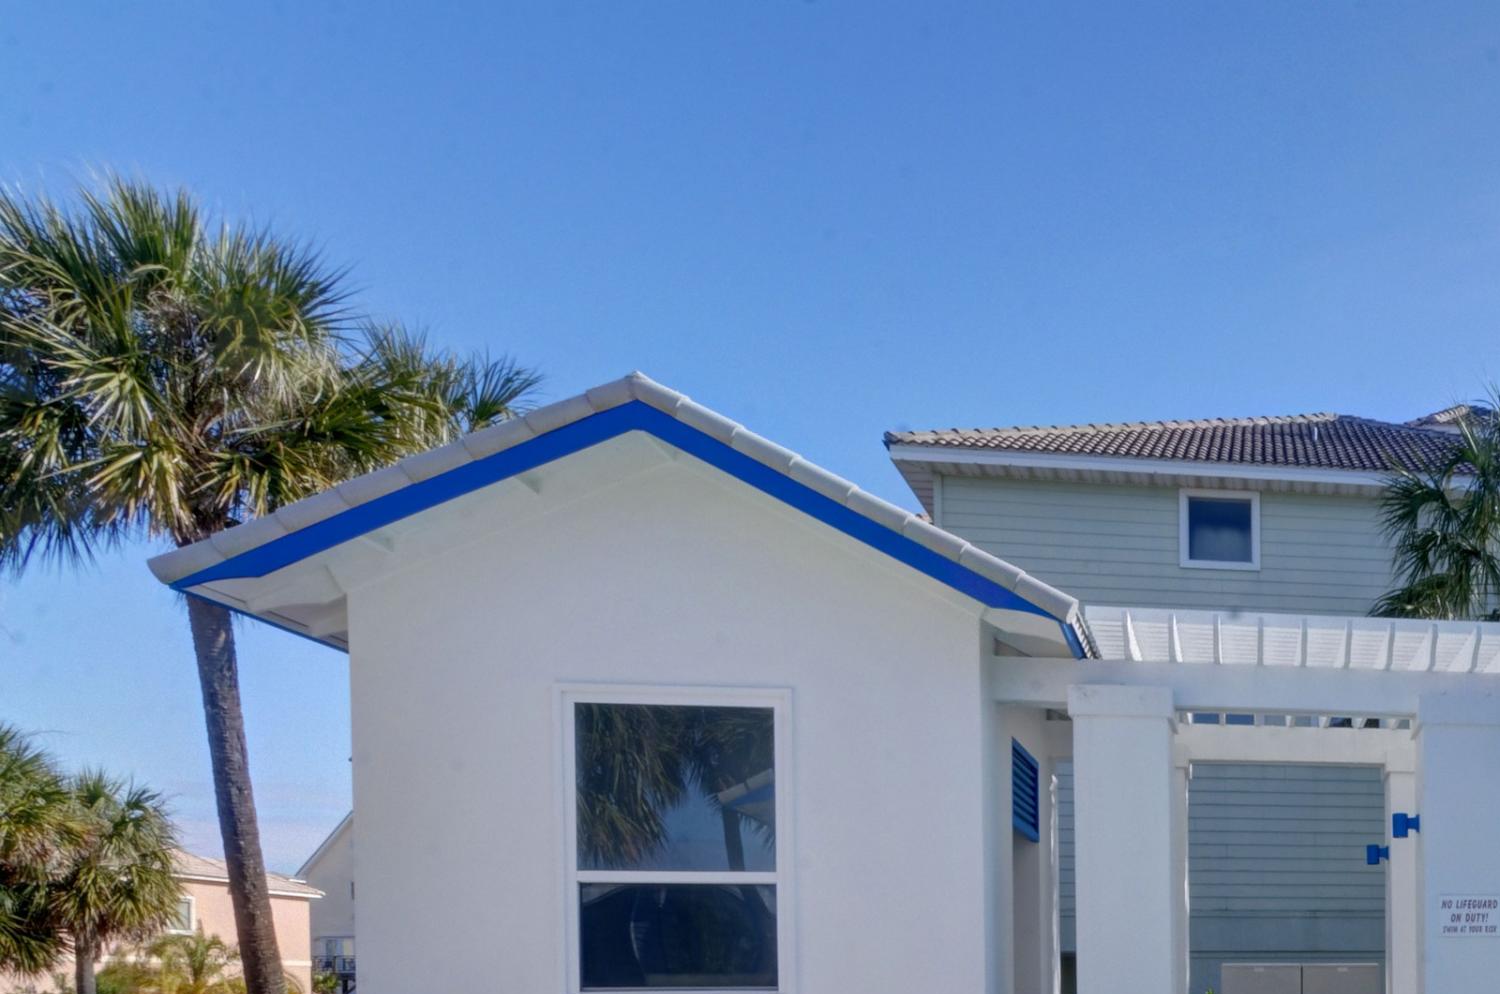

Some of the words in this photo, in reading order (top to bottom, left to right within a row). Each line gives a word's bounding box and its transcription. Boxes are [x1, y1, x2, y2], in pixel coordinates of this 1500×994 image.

[1441, 899, 1453, 909] NO
[1455, 899, 1498, 909] LIFEGUARD
[1451, 913, 1461, 922] ON
[1465, 913, 1489, 923] DUTY!
